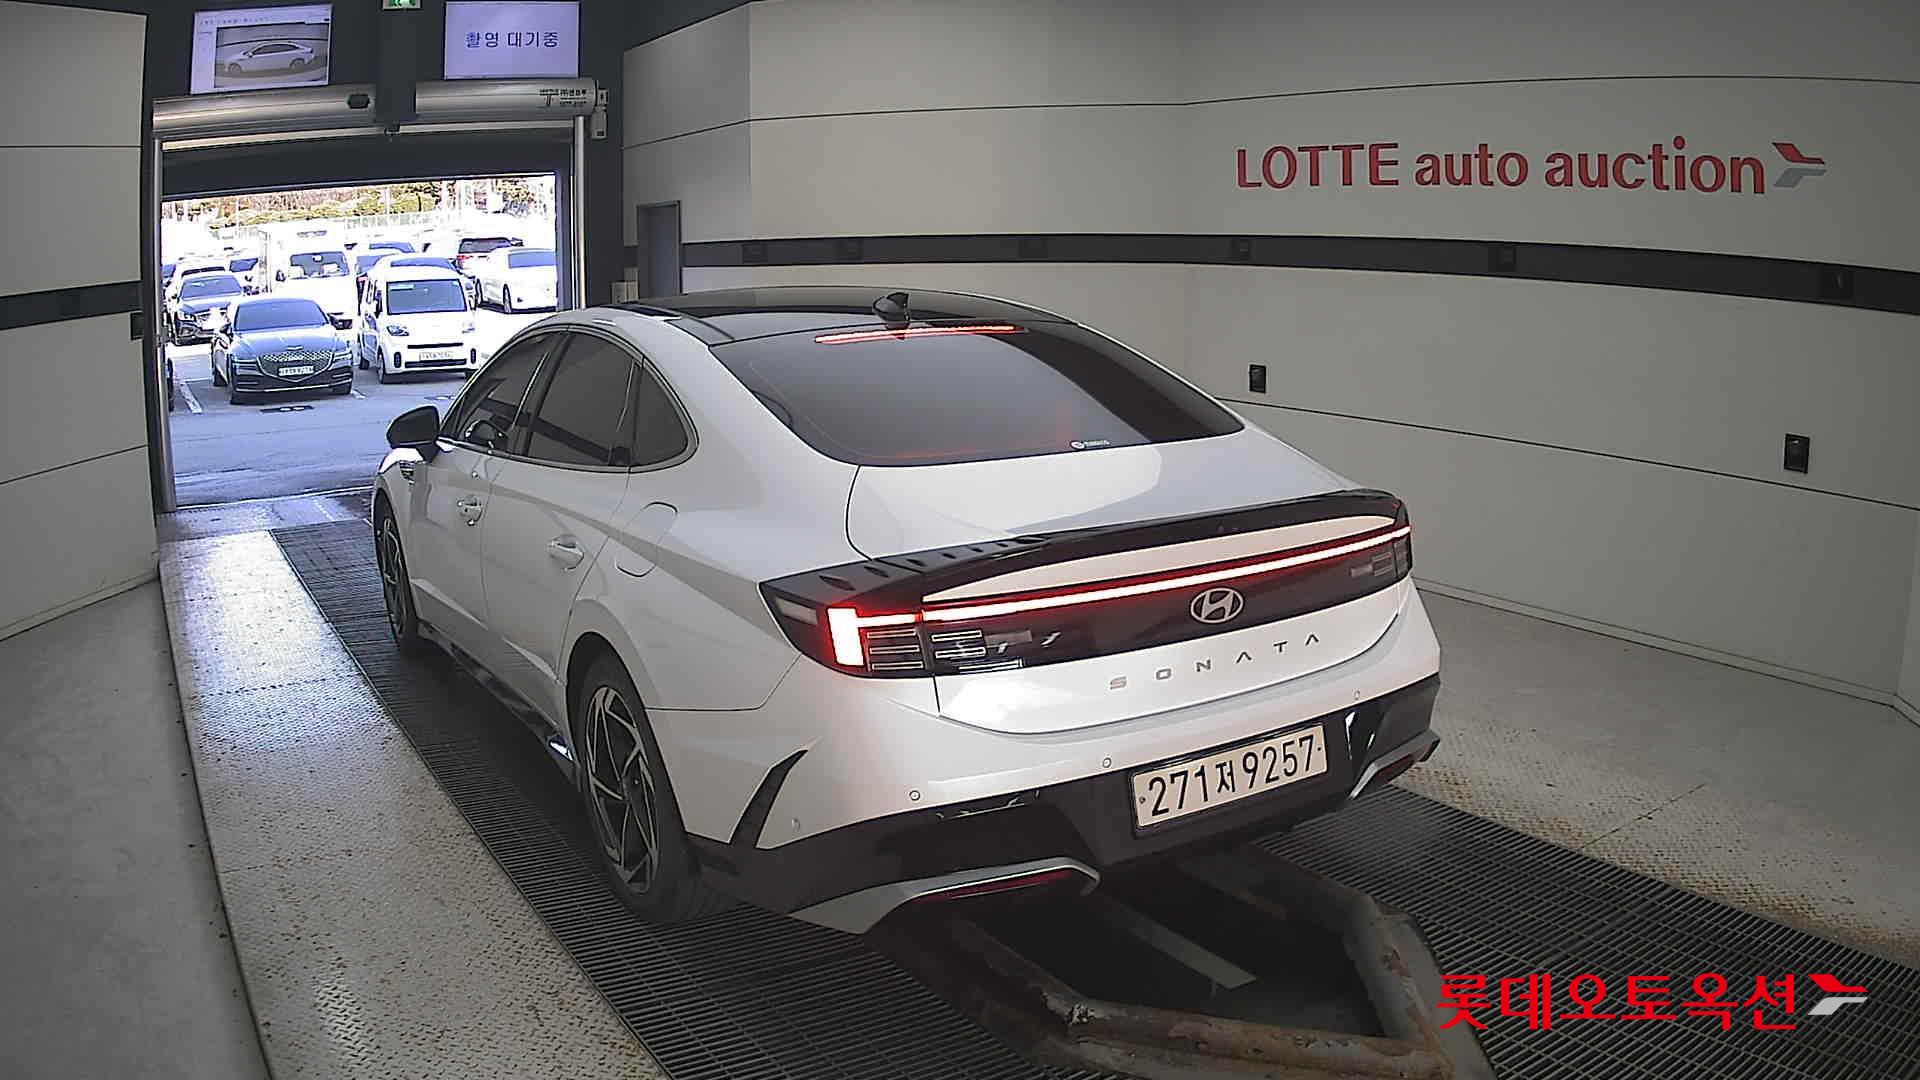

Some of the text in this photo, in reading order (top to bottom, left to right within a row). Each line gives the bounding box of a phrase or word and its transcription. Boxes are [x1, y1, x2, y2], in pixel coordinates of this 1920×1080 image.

[465, 31, 559, 48] 촬영 대기중
[1237, 137, 1765, 194] LOTTE auto auction
[1109, 633, 1320, 690] SONATA
